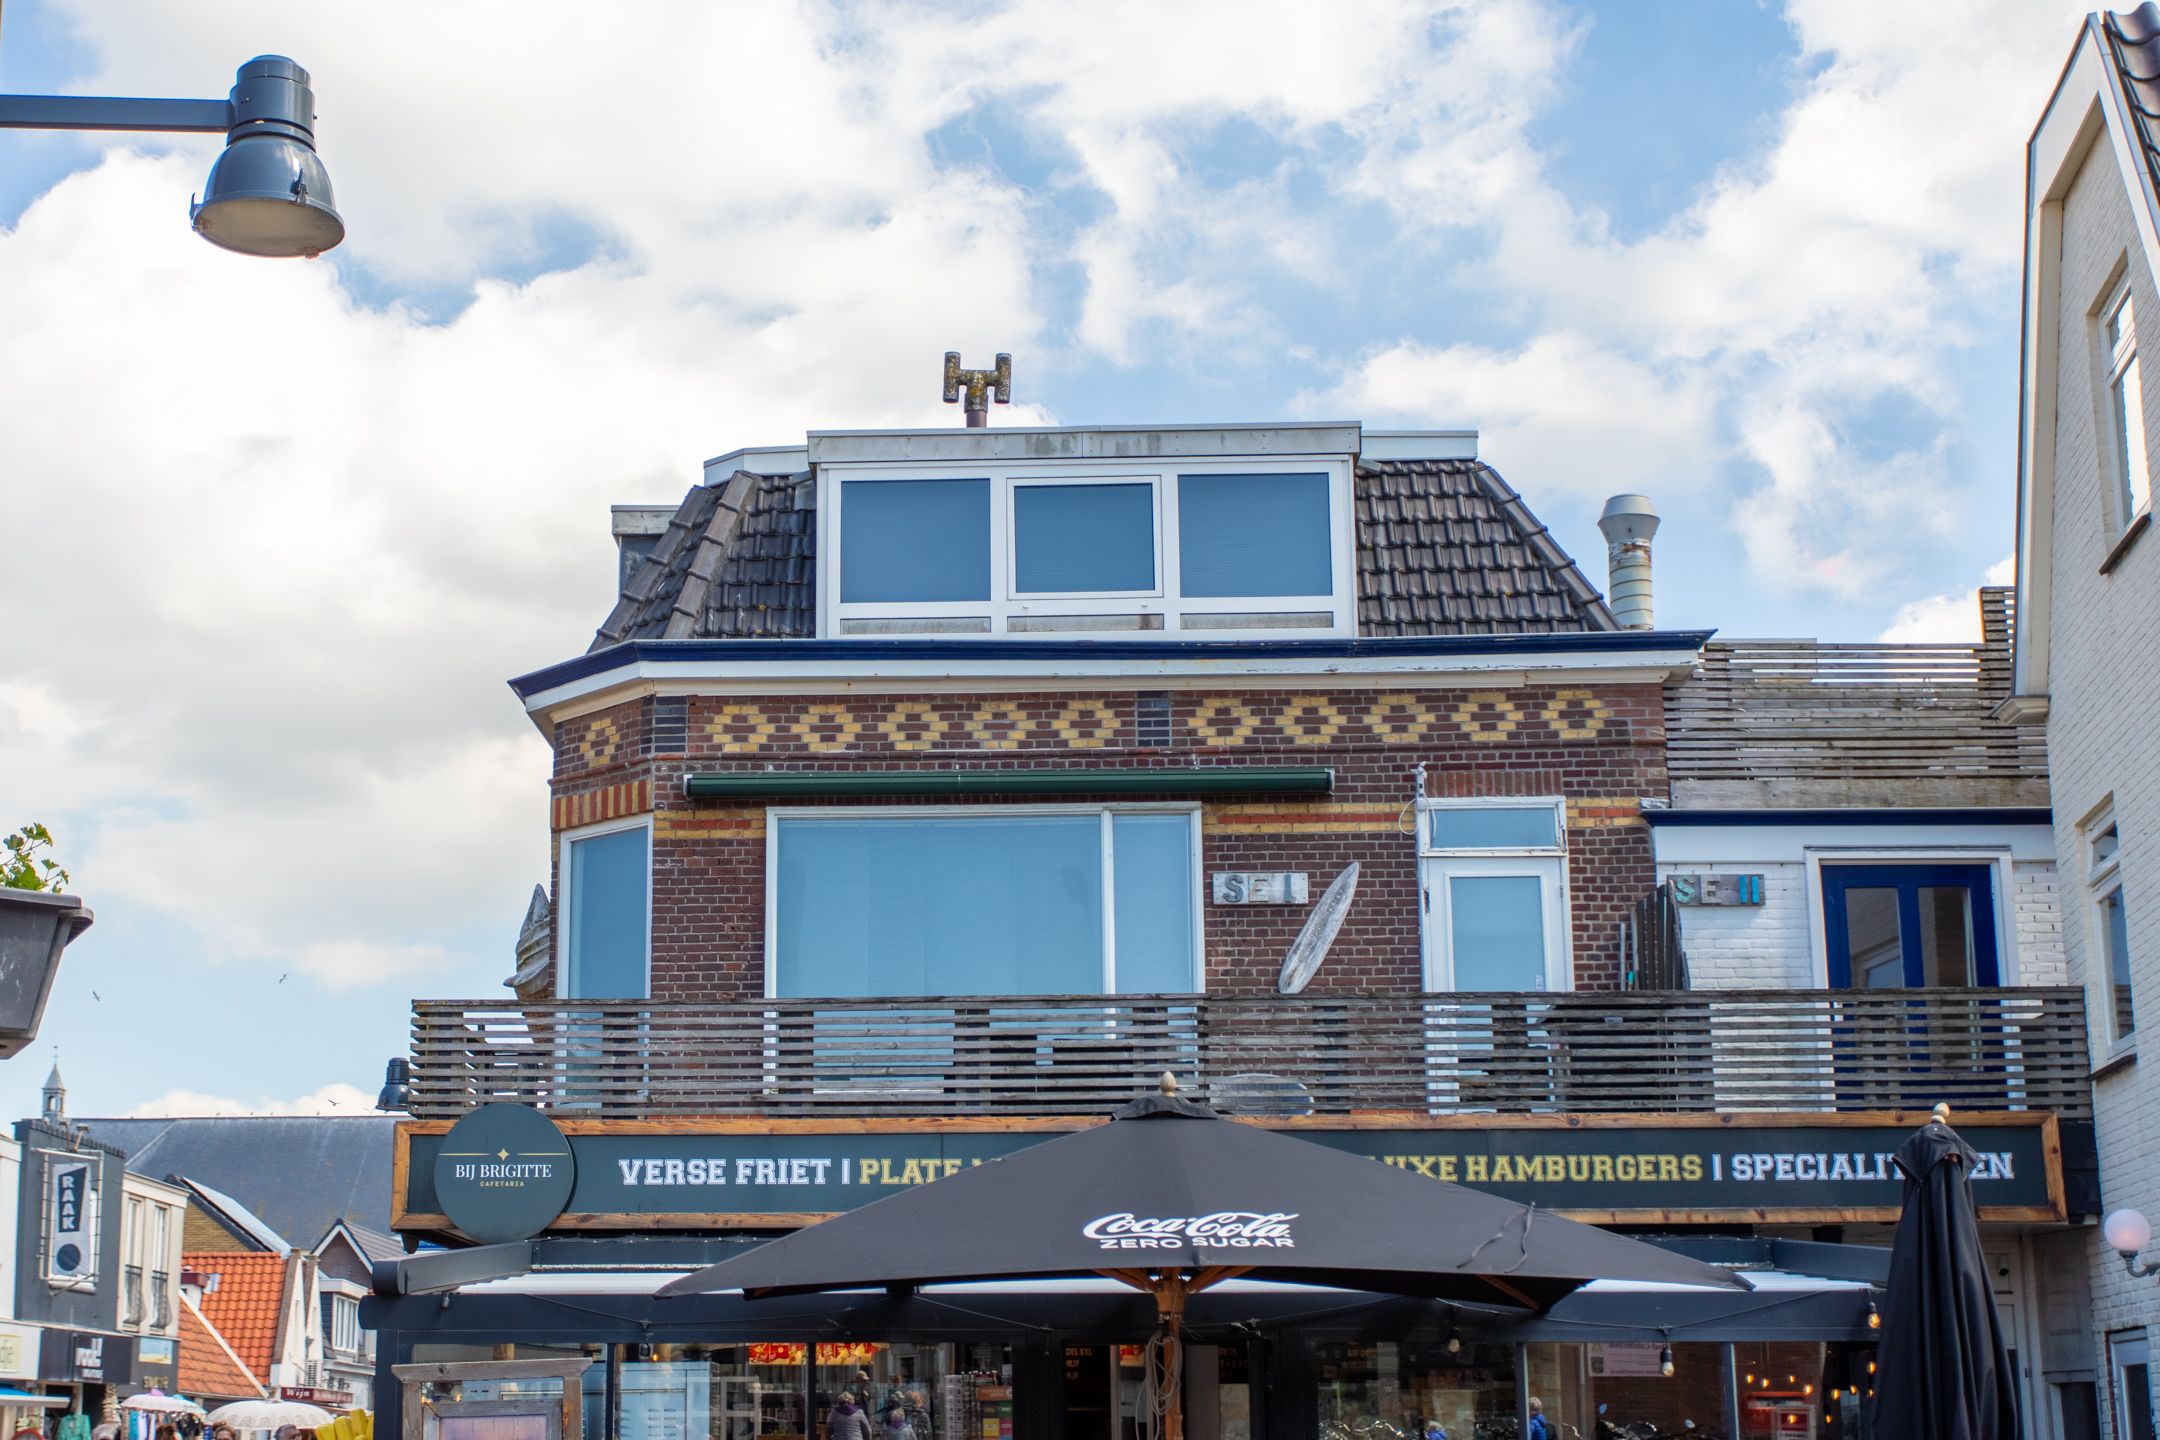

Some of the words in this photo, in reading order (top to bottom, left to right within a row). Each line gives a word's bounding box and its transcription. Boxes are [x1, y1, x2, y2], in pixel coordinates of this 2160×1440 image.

[455, 1164, 477, 1181] BIJ
[480, 1164, 552, 1178] BRIGITTE
[618, 1158, 727, 1186] VERSE
[735, 1158, 832, 1186] FRIET
[1464, 1153, 1703, 1182] HAMBURGERS
[62, 1175, 76, 1230] RAAK
[1099, 1239, 1183, 1249] ZERO
[1191, 1236, 1295, 1248] SUGAR
